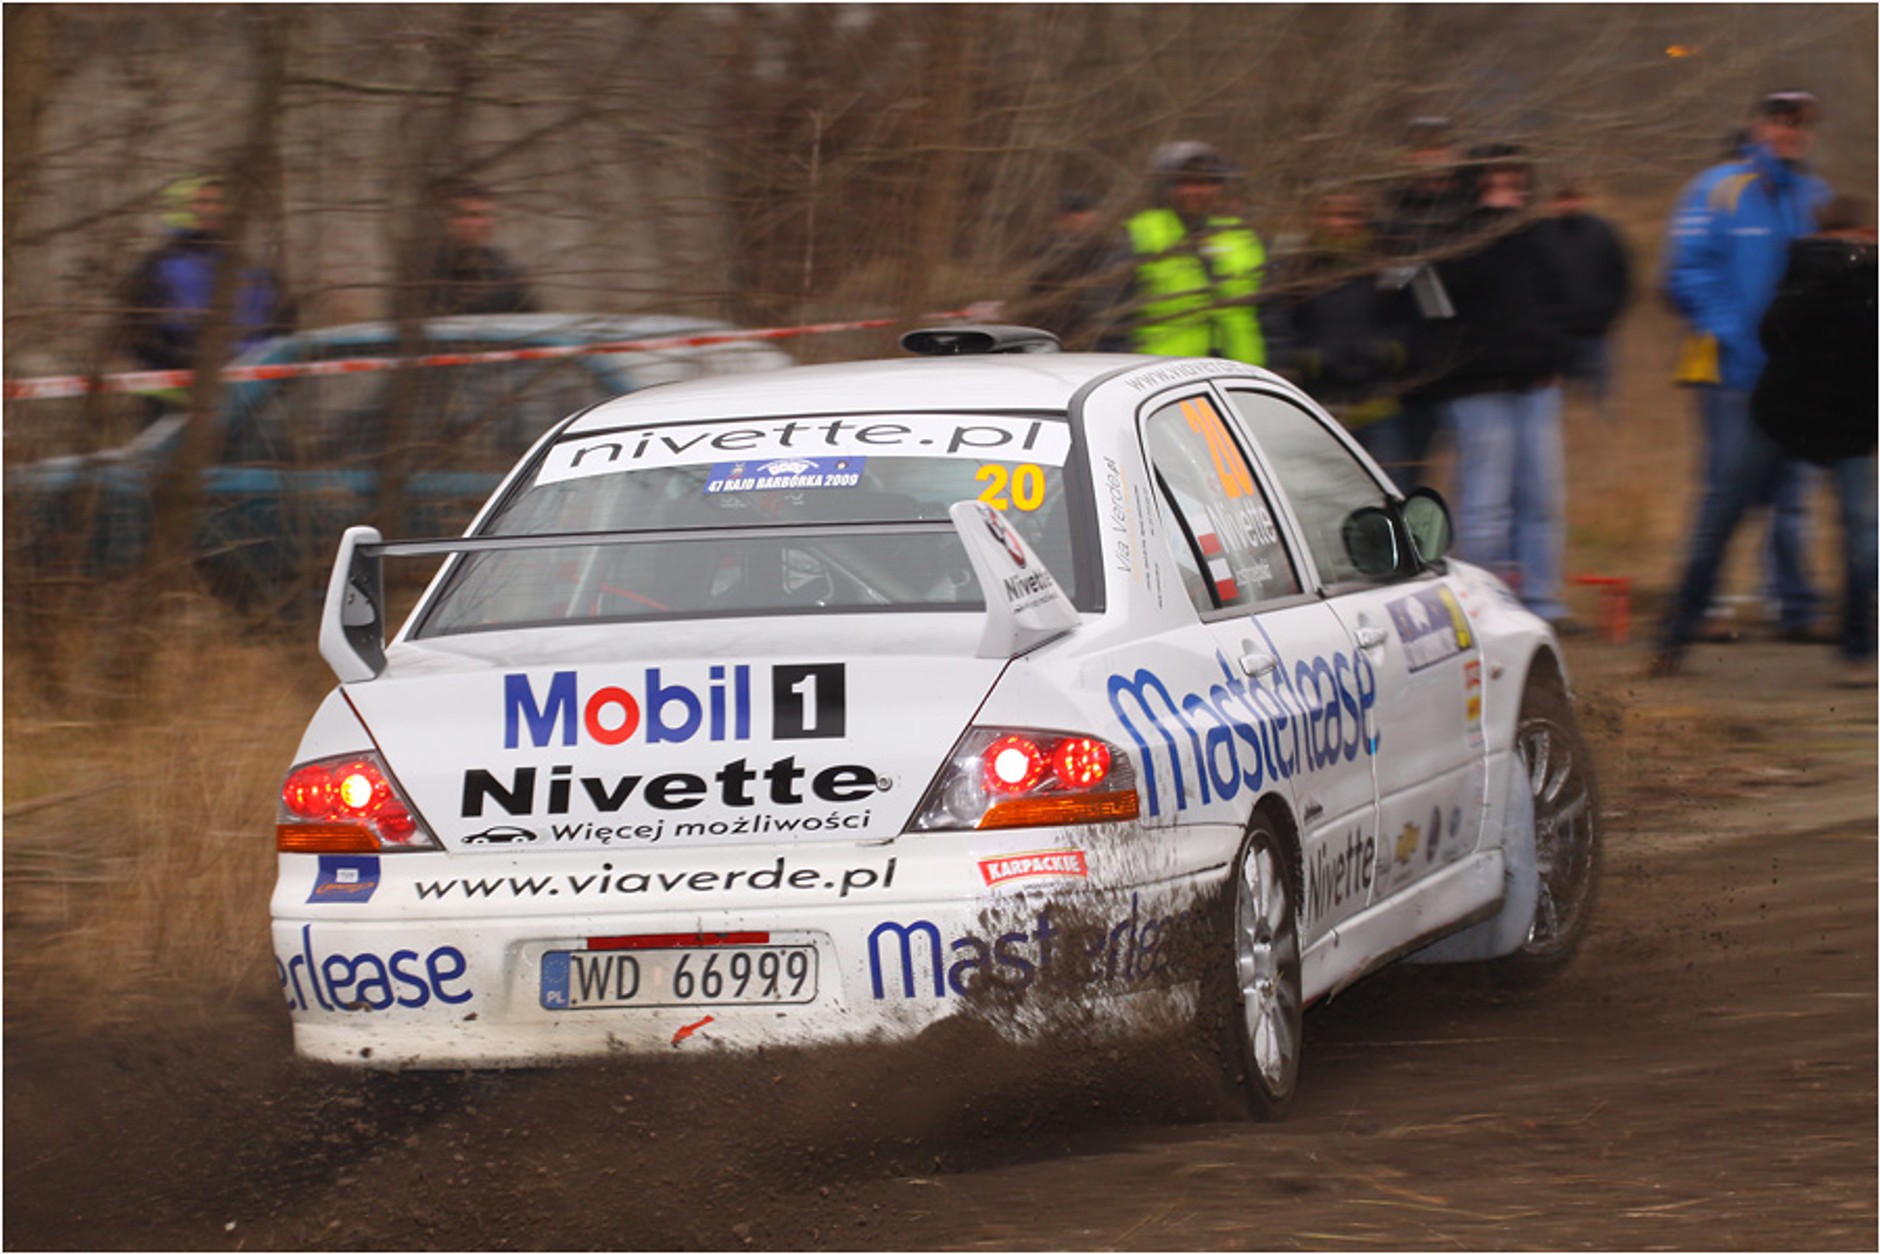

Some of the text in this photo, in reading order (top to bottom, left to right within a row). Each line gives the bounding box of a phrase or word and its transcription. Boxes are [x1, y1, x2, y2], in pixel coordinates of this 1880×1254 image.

[568, 418, 1039, 468] nivette.pl
[1179, 397, 1255, 499] 20
[708, 479, 724, 493] 47
[723, 478, 755, 492] RAJD
[824, 473, 861, 487] 2009
[974, 463, 1046, 512] 20
[1117, 541, 1132, 573] Via
[504, 665, 751, 749] Mobil
[460, 756, 878, 818] Nivette
[551, 809, 872, 845] Więcej możliwości
[414, 856, 895, 900] www.viaverde.pl
[986, 852, 1081, 881] KARPACKIE
[1306, 827, 1375, 928] Nivette
[546, 951, 809, 1004] PL WD 66999
